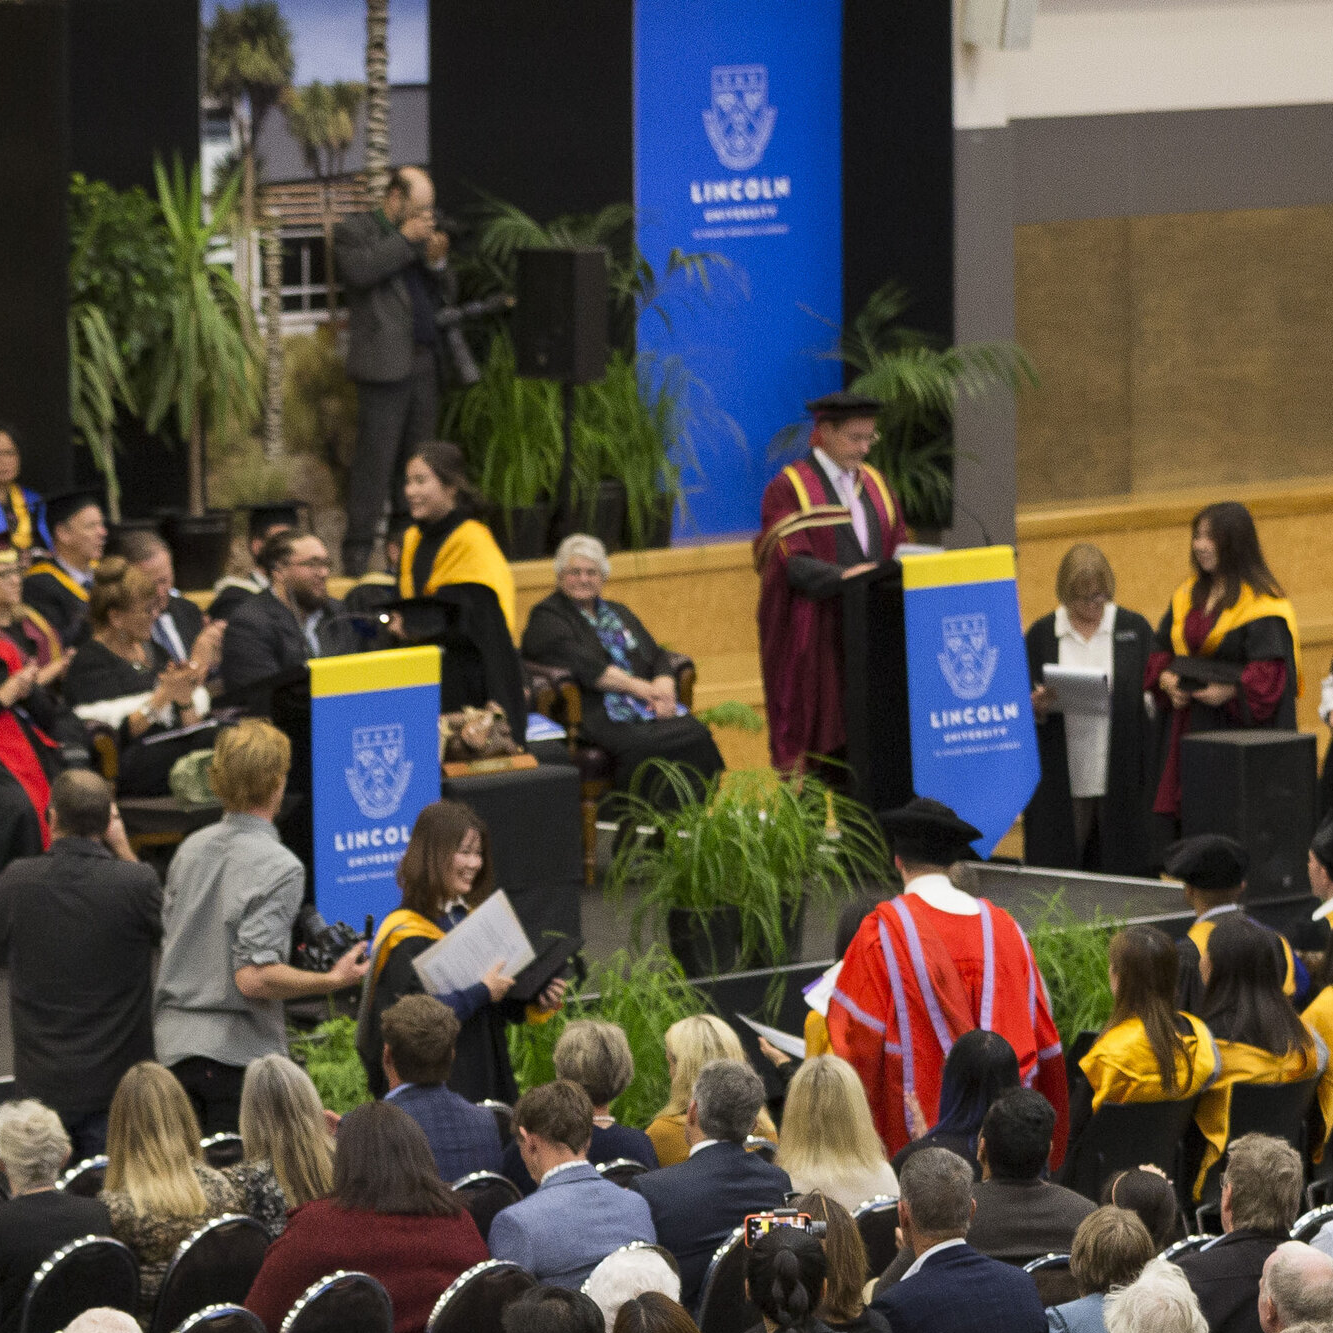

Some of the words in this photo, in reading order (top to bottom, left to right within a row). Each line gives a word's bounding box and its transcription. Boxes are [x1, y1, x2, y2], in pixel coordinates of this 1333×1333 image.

[690, 176, 790, 204] LINCOLN
[930, 703, 1018, 728] LINCOLN
[334, 825, 411, 852] LINCOL
